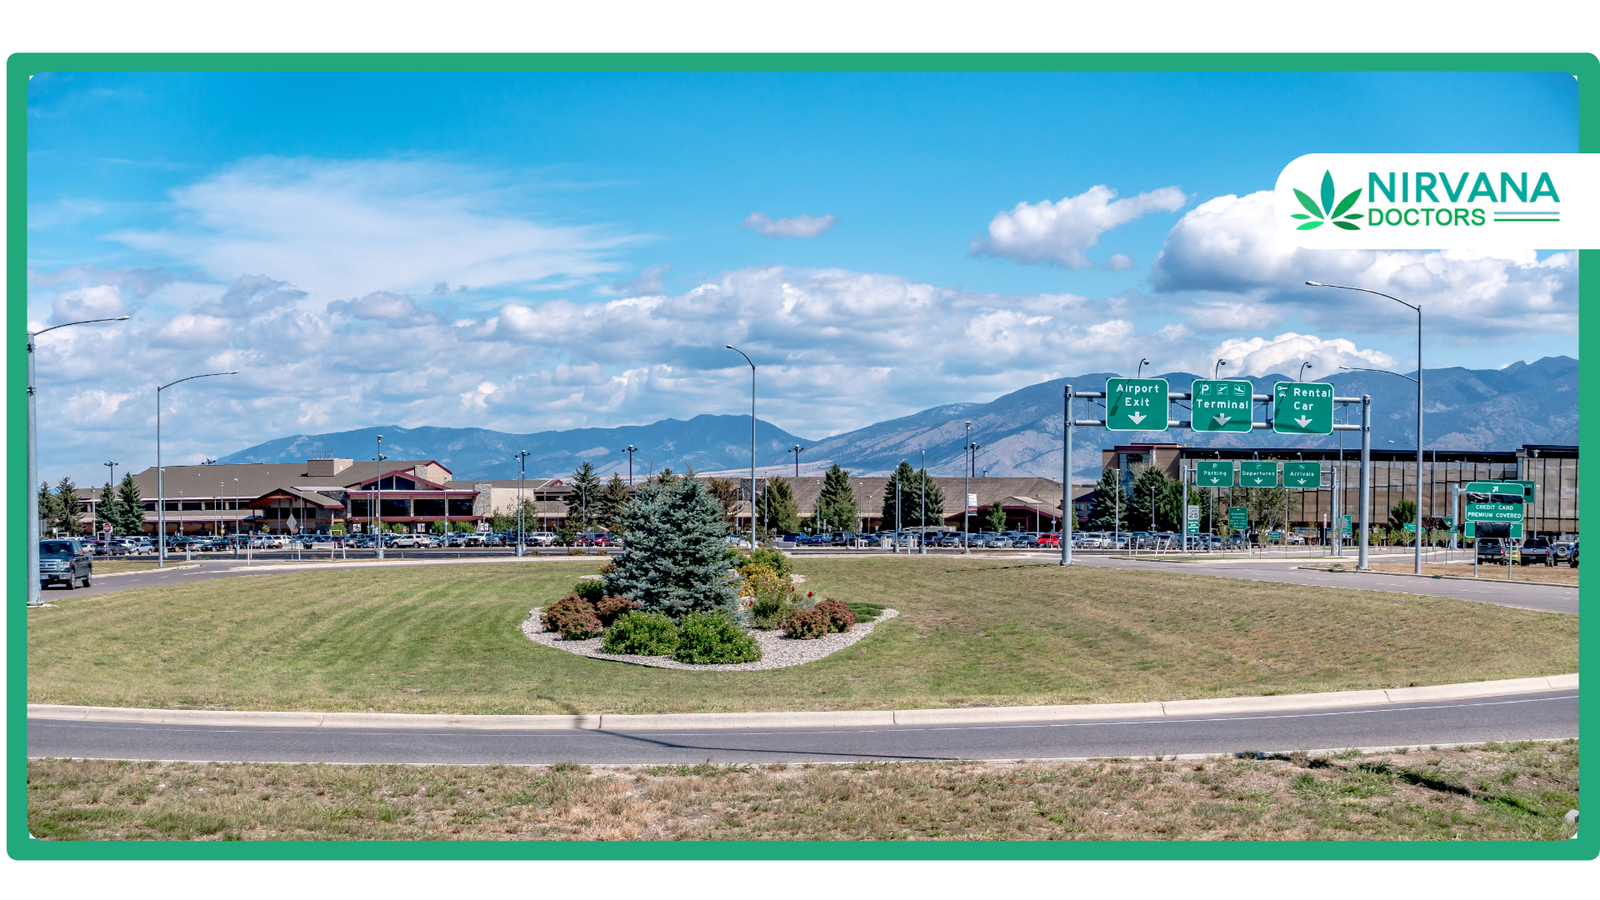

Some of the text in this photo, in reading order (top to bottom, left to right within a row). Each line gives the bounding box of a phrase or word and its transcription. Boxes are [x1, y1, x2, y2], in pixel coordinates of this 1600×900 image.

[1116, 384, 1159, 395] Airport
[1293, 387, 1331, 398] Rental
[1125, 397, 1150, 407] Exit
[1196, 399, 1249, 409] Terminal
[1293, 401, 1314, 411] Car
